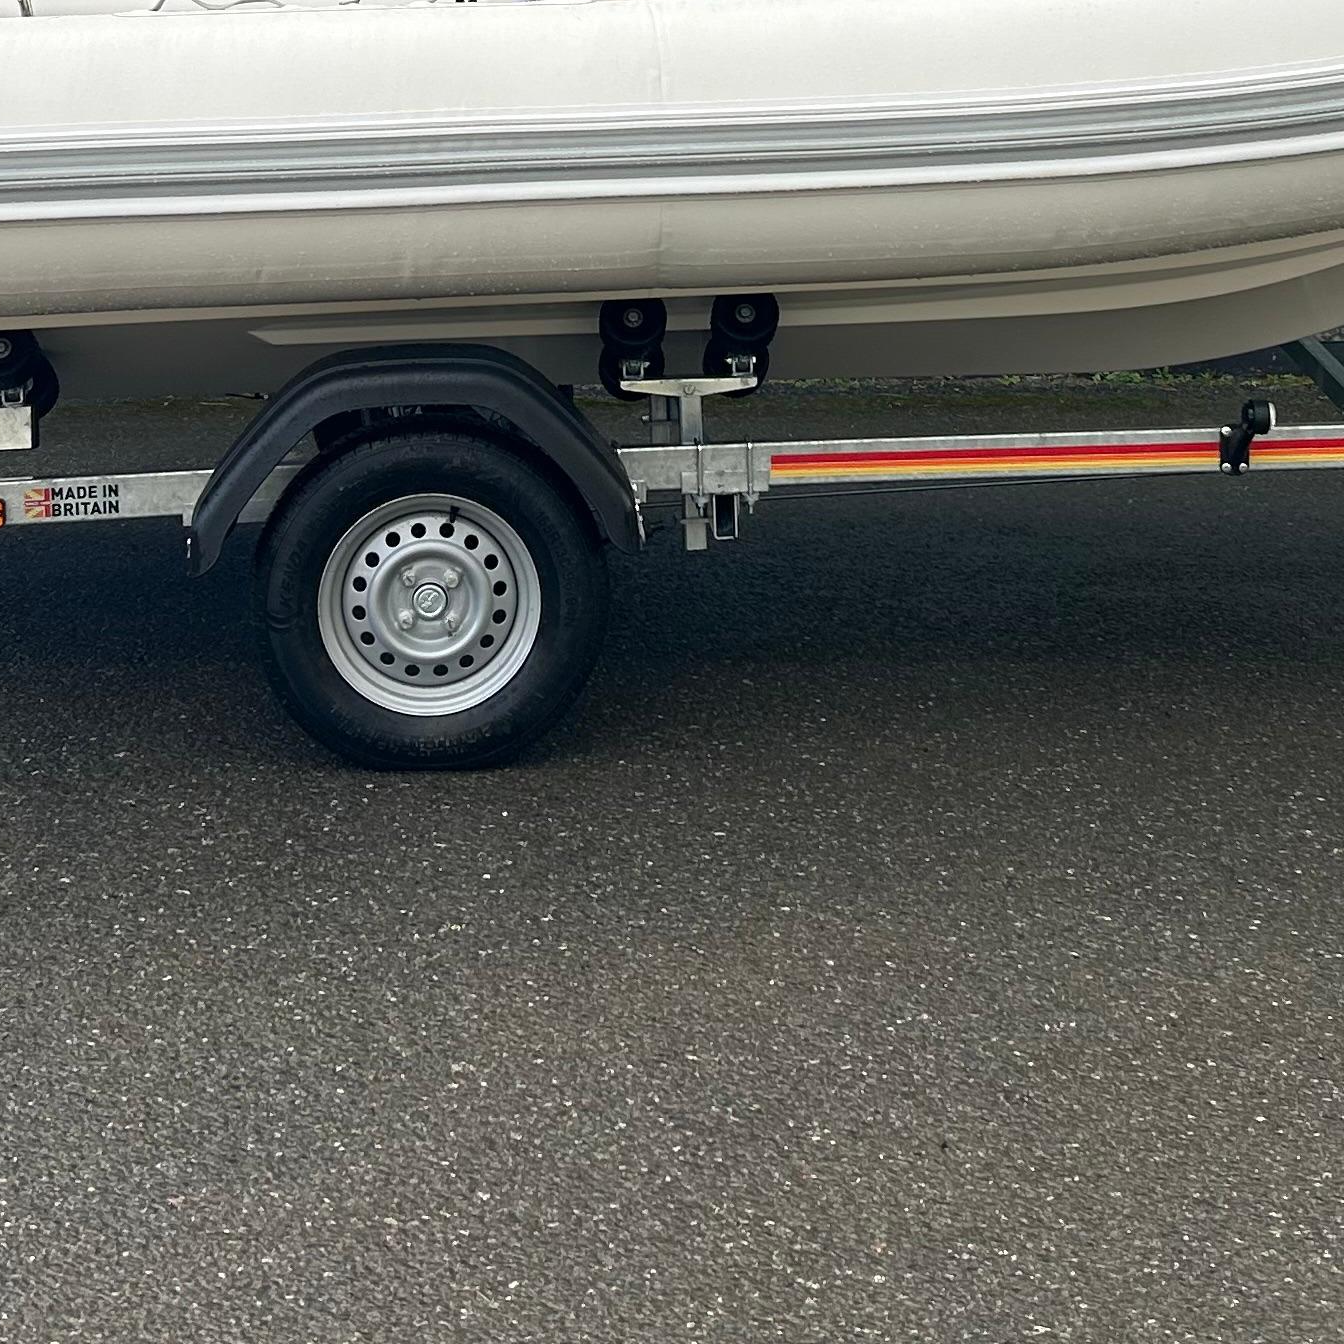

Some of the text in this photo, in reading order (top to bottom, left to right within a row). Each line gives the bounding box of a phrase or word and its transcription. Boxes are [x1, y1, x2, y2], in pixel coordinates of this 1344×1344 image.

[51, 484, 119, 500] MADE IN
[51, 500, 120, 517] BRITAIN
